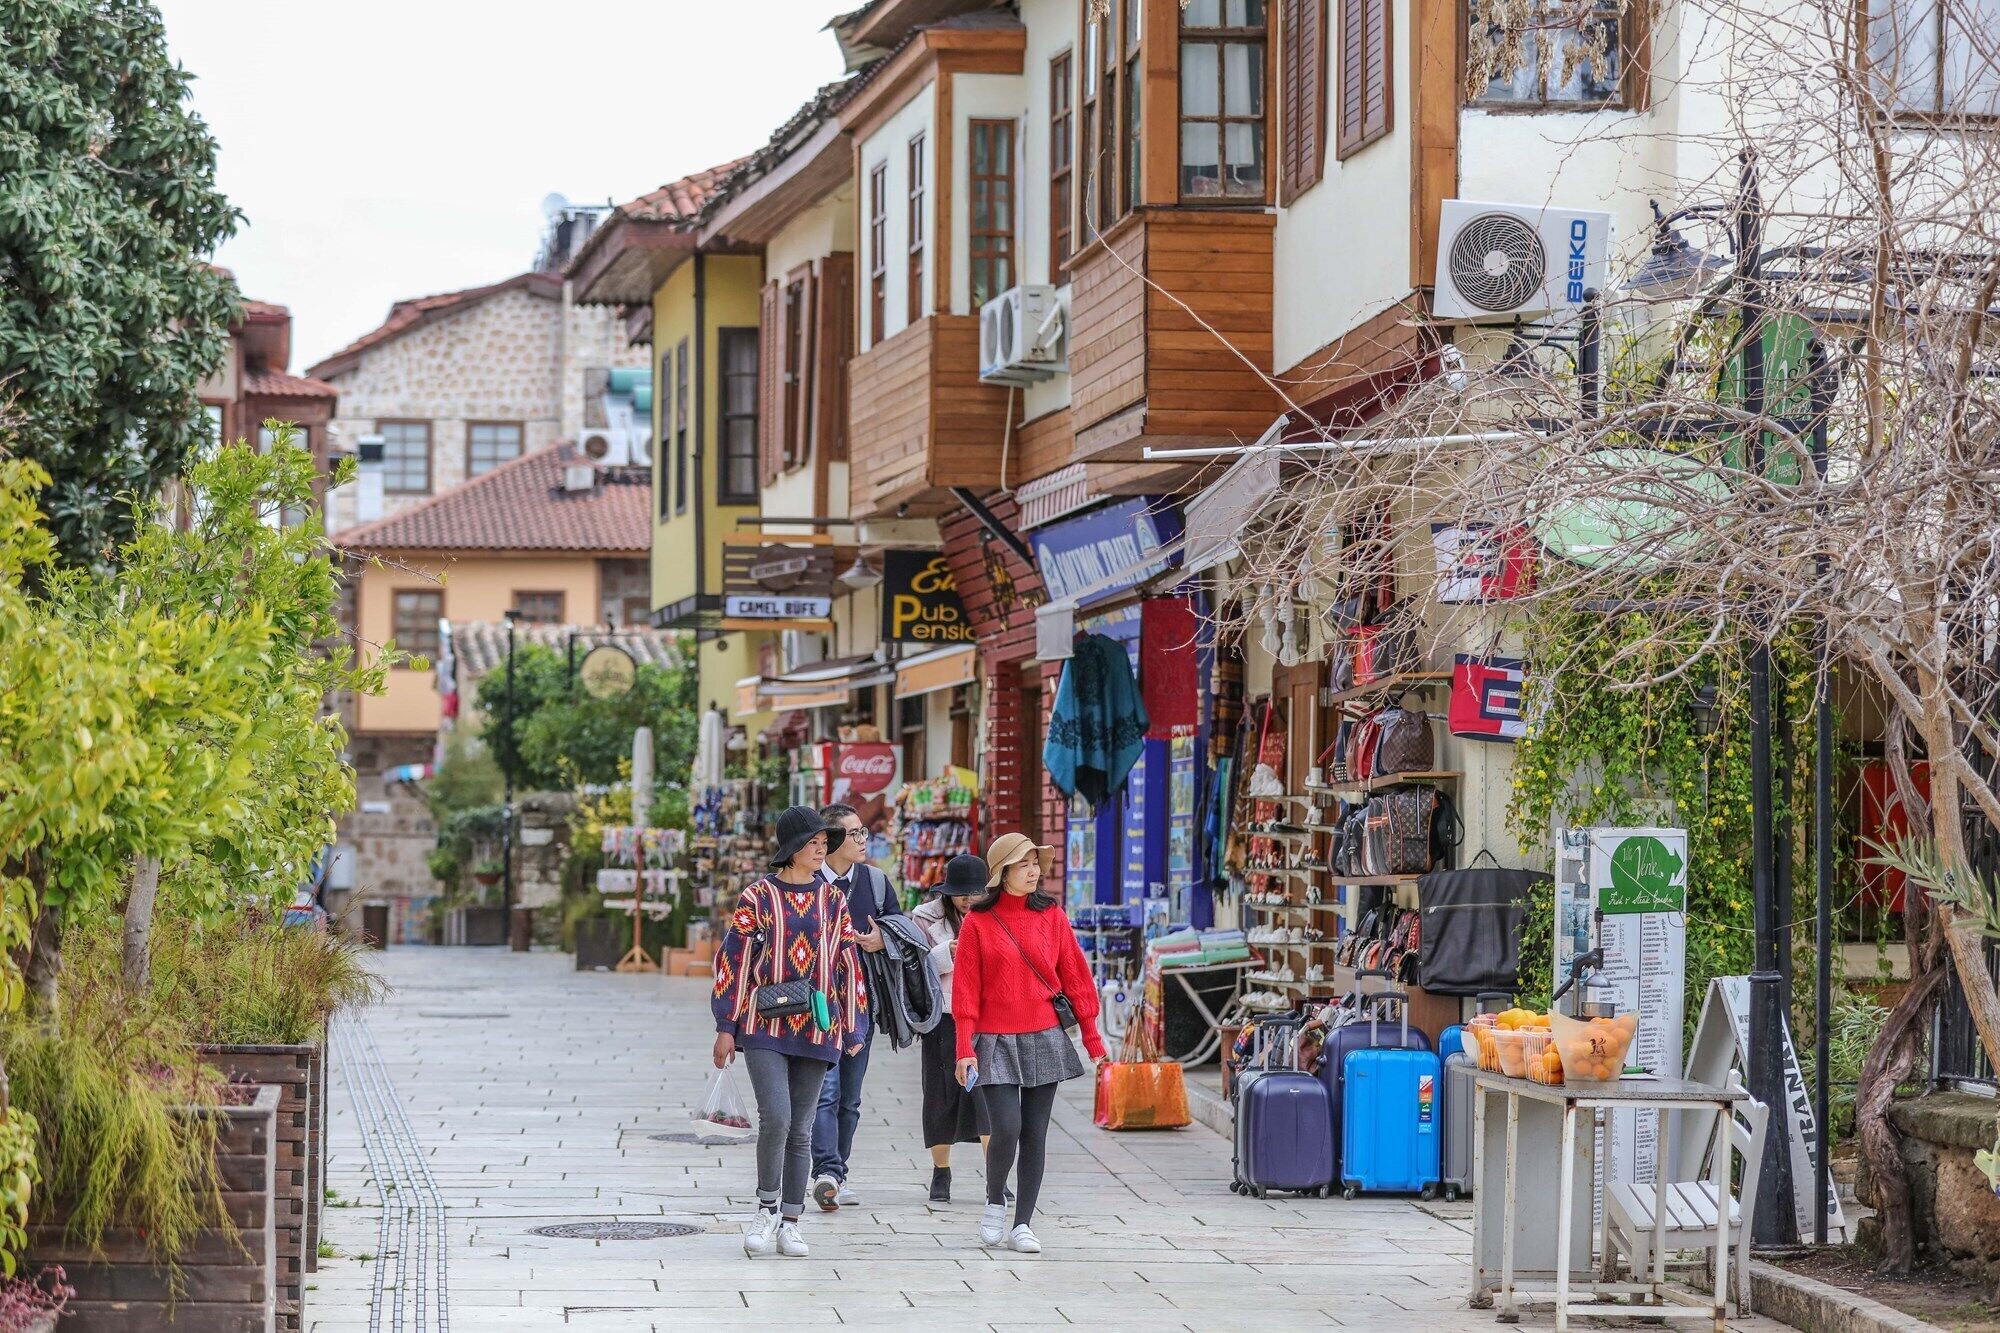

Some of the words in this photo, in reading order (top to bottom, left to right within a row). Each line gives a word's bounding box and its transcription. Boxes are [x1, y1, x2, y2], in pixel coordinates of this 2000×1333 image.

[1567, 220, 1587, 303] BEKO
[740, 602, 779, 614] CAMEL
[840, 754, 893, 774] Coca-Cola
